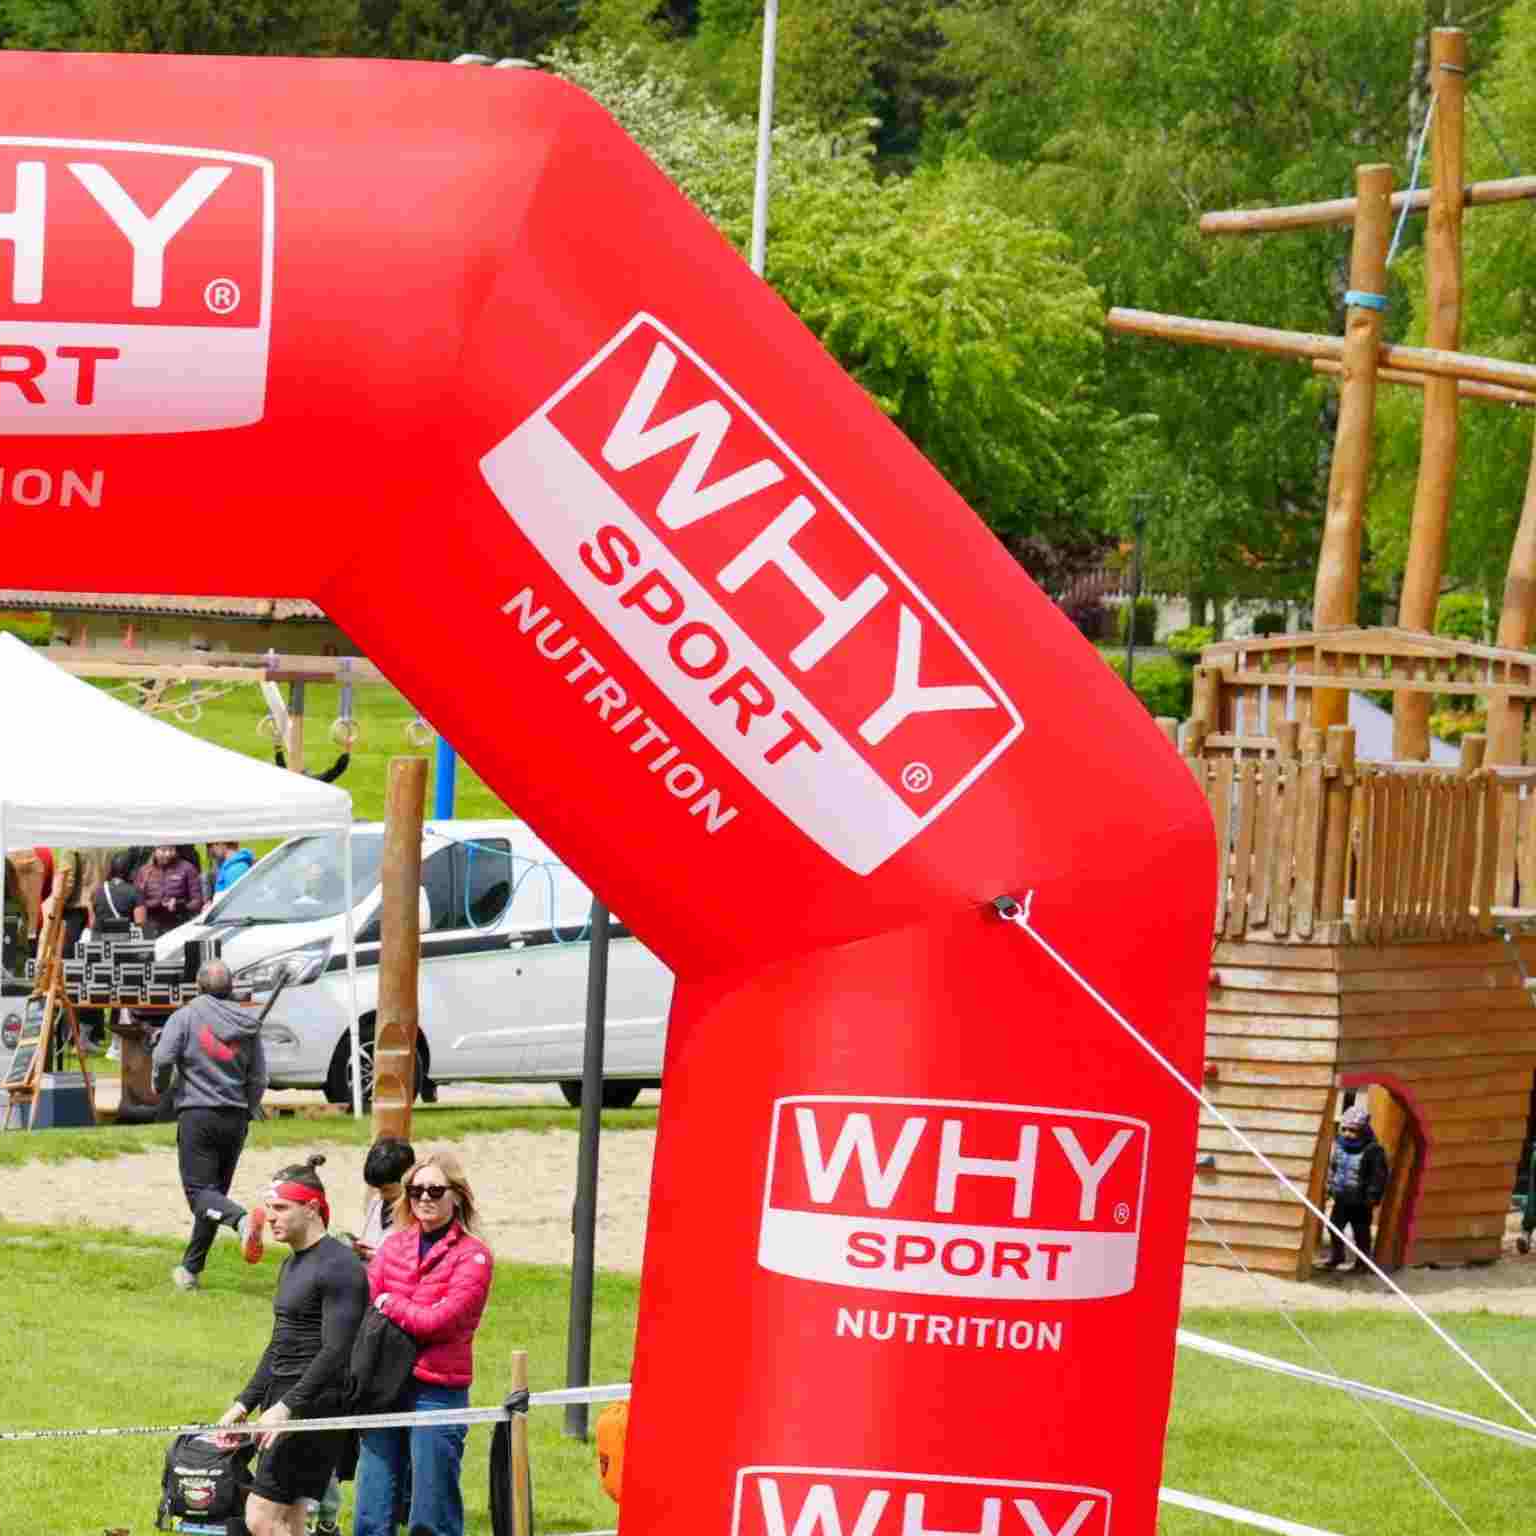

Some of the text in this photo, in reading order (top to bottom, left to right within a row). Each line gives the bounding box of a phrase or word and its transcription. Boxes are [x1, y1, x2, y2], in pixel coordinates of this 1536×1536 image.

[502, 587, 738, 834] NUTRITION
[579, 525, 823, 767] SPORT
[846, 1231, 1072, 1280] SPORT
[835, 1308, 1062, 1350] NUTRITION
